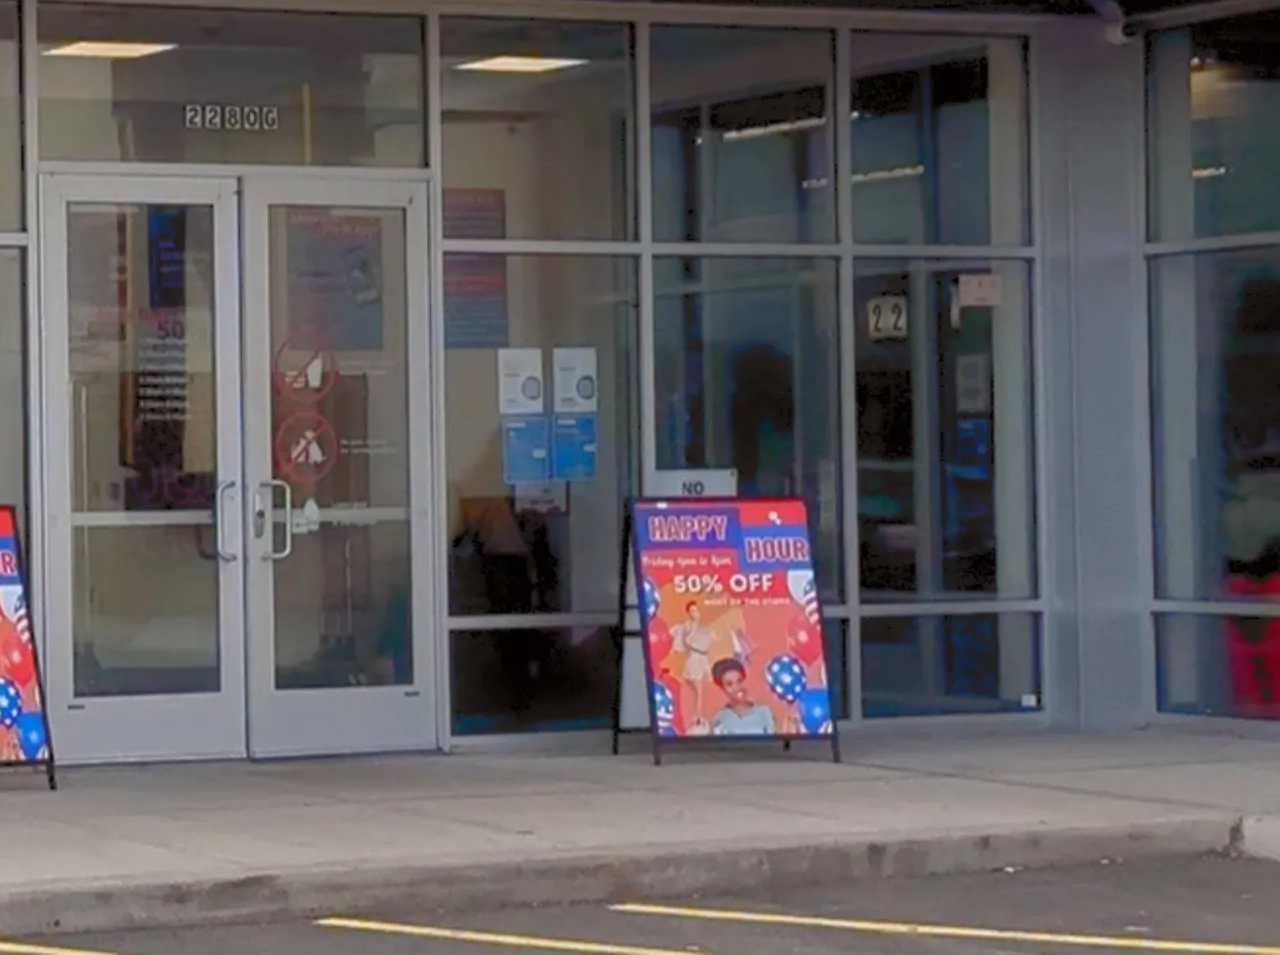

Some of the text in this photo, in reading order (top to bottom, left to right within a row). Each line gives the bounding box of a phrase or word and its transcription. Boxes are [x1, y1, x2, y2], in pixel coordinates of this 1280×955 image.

[681, 481, 705, 495] NO
[648, 515, 728, 542] HAPPY
[744, 536, 809, 562] HOUR
[673, 573, 773, 593] 50% OFF
